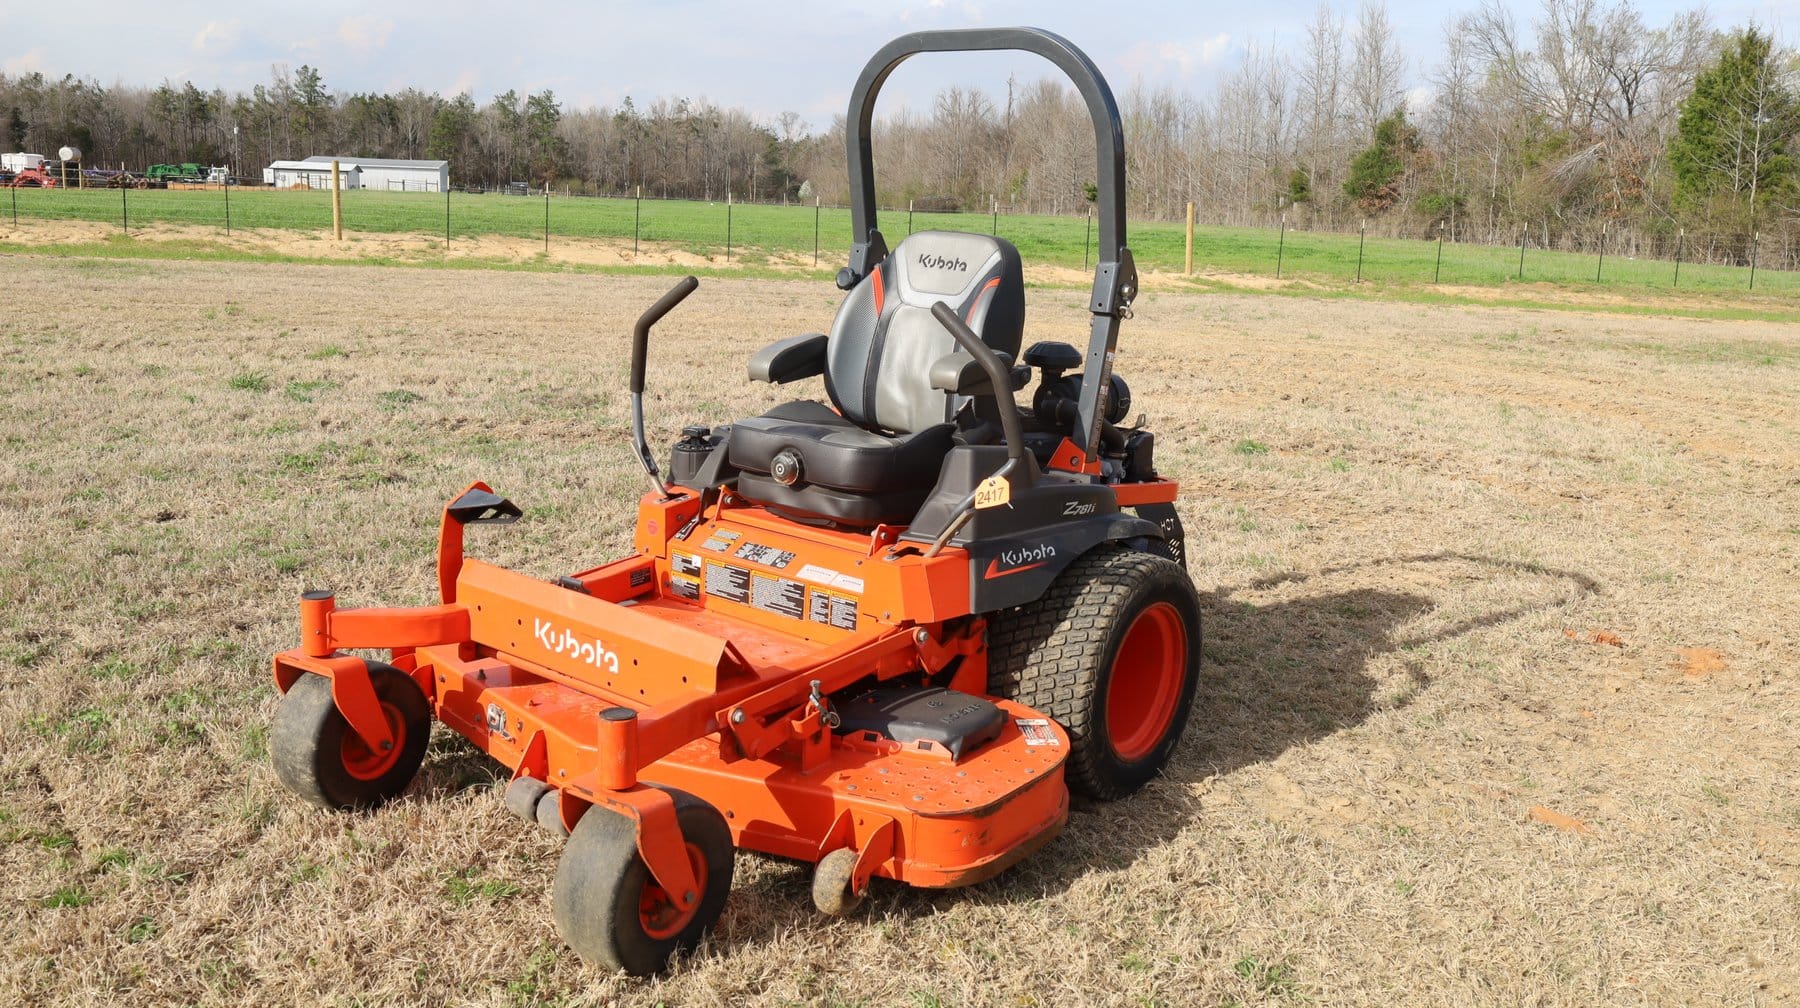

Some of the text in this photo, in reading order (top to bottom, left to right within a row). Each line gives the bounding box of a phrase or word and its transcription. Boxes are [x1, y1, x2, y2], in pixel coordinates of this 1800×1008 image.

[918, 254, 968, 272] Kubota
[977, 487, 1004, 505] 2417
[1001, 543, 1057, 566] Kubota
[534, 617, 619, 675] Kubota
